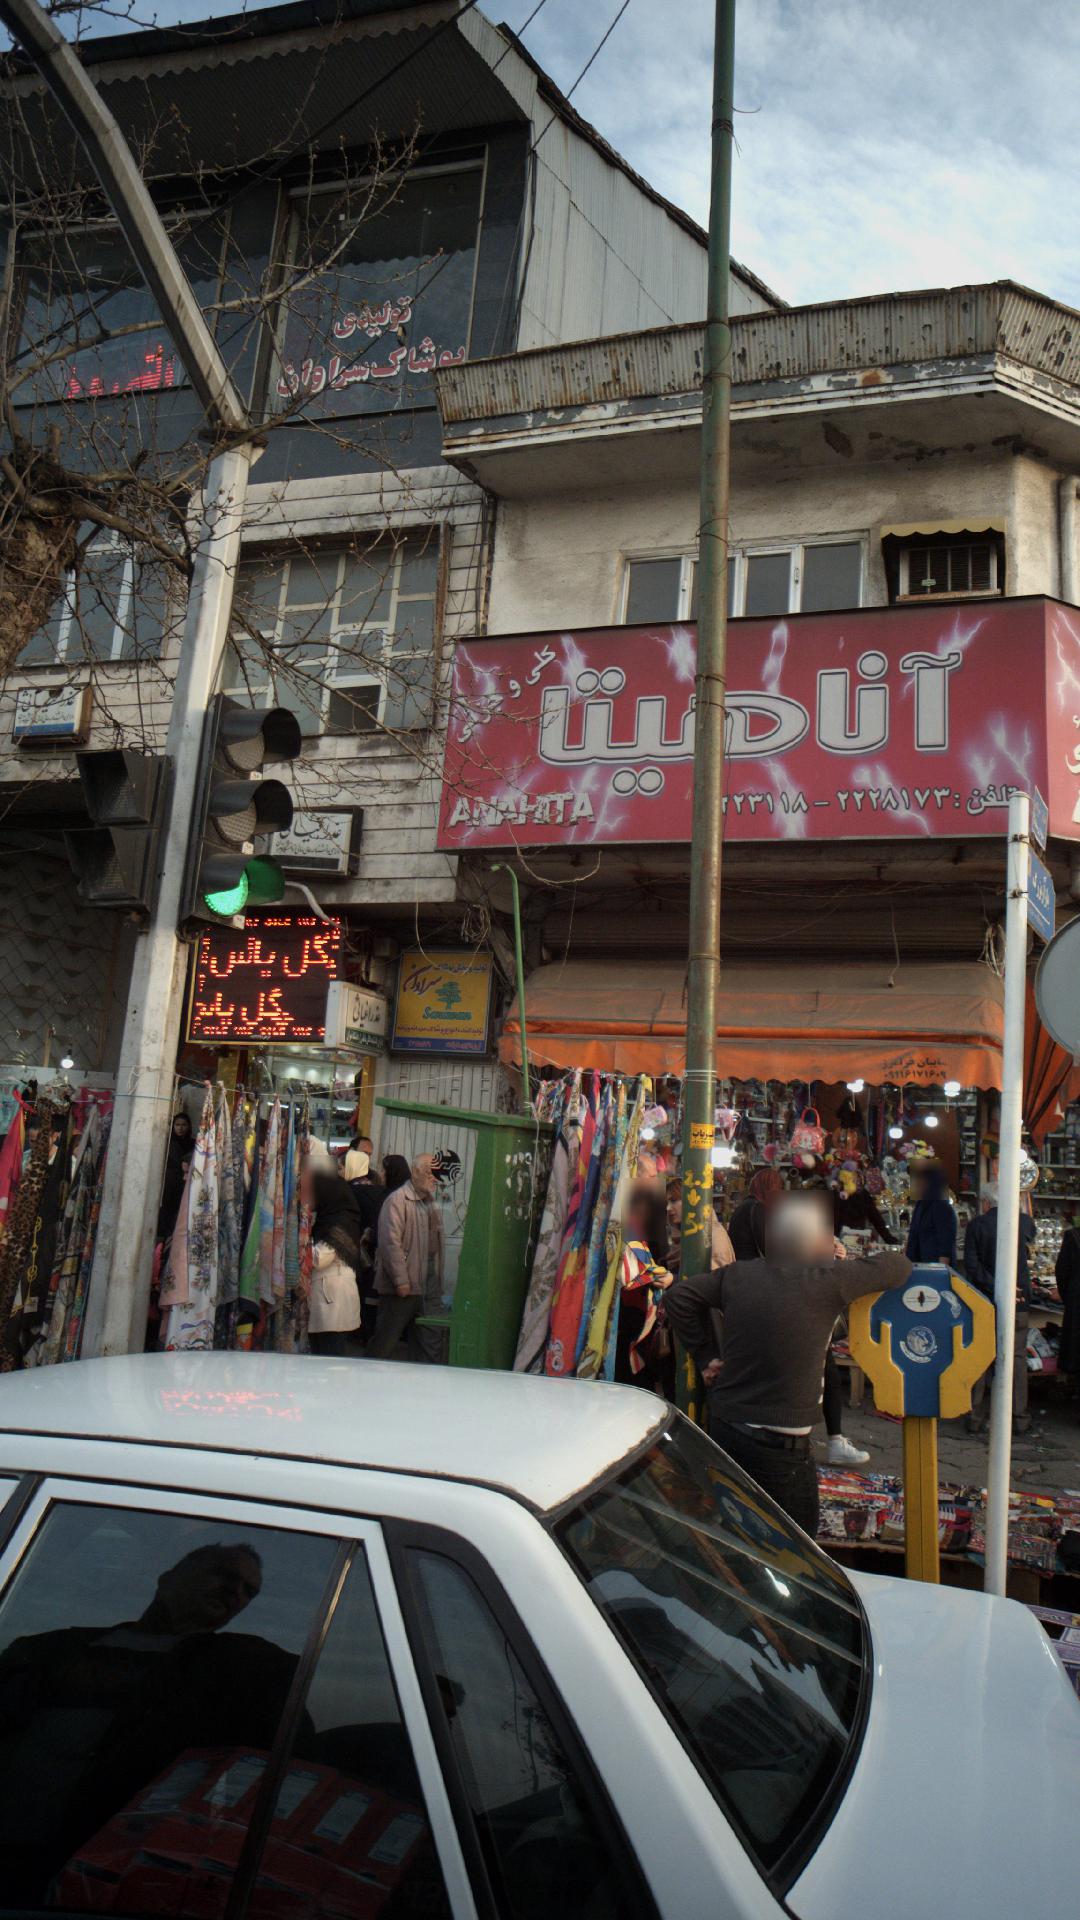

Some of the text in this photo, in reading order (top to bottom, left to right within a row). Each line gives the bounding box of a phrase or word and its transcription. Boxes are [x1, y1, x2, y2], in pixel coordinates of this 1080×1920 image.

[537, 648, 963, 797] آناهیتا
[449, 793, 596, 829] ANAHITA
[836, 787, 949, 812] ۲۲۲۸۱۷۳
